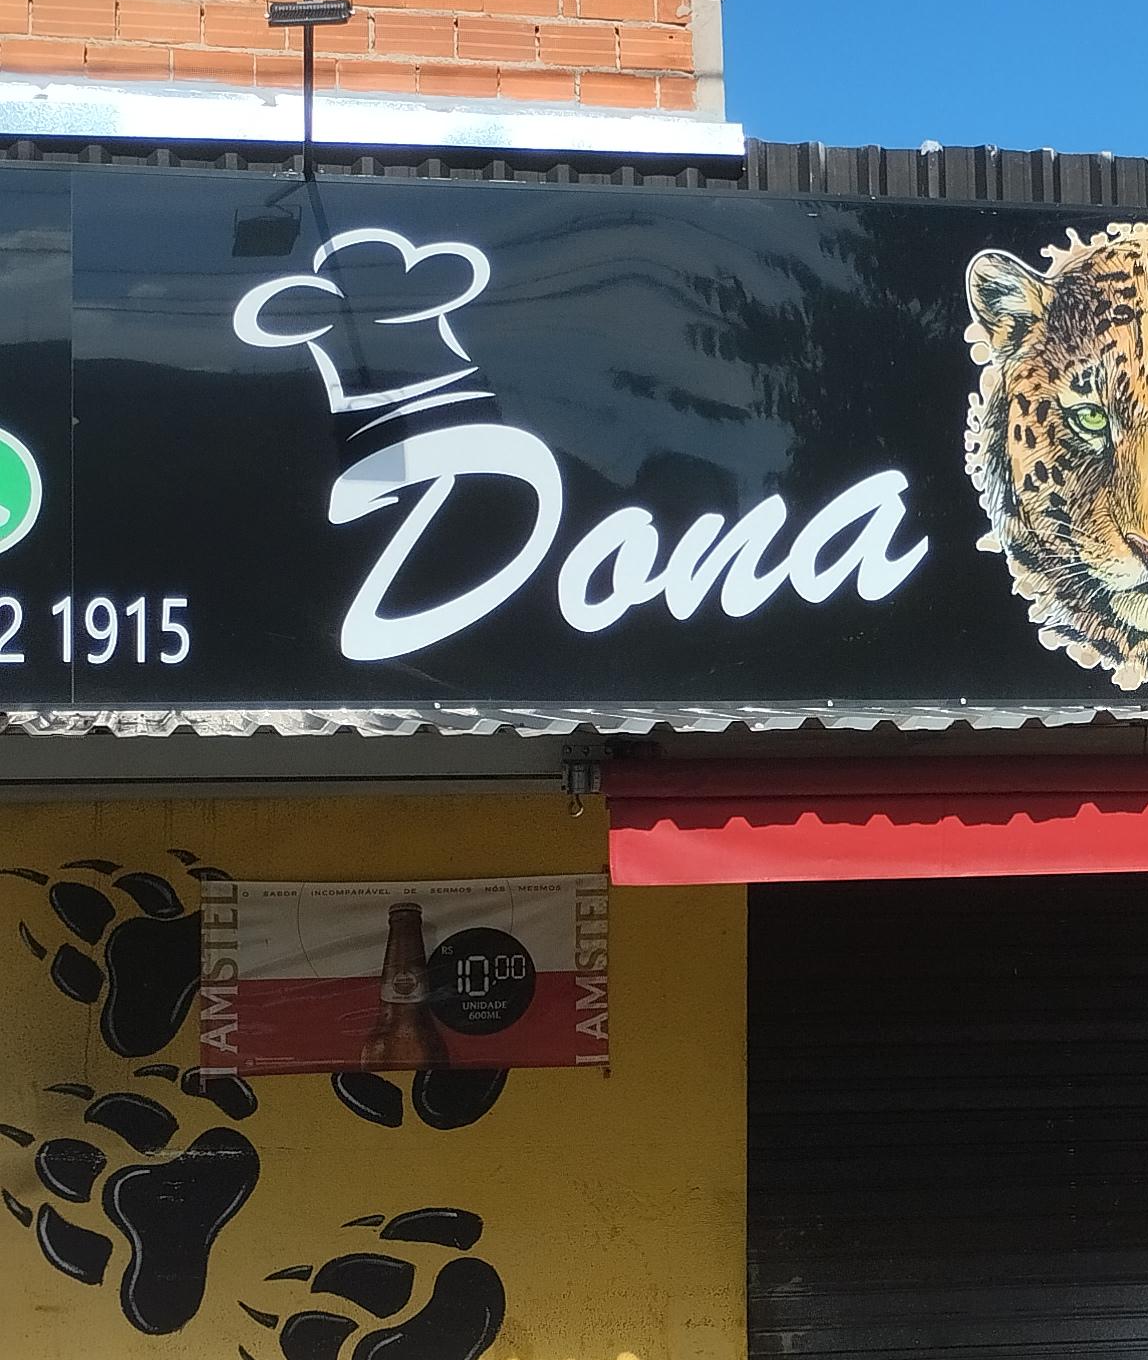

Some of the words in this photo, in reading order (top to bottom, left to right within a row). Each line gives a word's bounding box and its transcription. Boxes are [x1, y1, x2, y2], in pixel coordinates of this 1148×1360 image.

[329, 424, 929, 660] Dona
[52, 596, 190, 664] 1915
[263, 889, 298, 898] SABOR
[311, 886, 391, 897] INCOMPARÁVEL
[404, 887, 417, 895] DE
[430, 885, 472, 894] SERMOS
[485, 883, 506, 893] NÓS
[518, 883, 562, 892] MESMOS
[200, 883, 239, 1055] AMSTEL
[457, 955, 526, 997] 10,00
[462, 1000, 508, 1011] UNIDADE
[469, 1010, 503, 1021] 600ML
